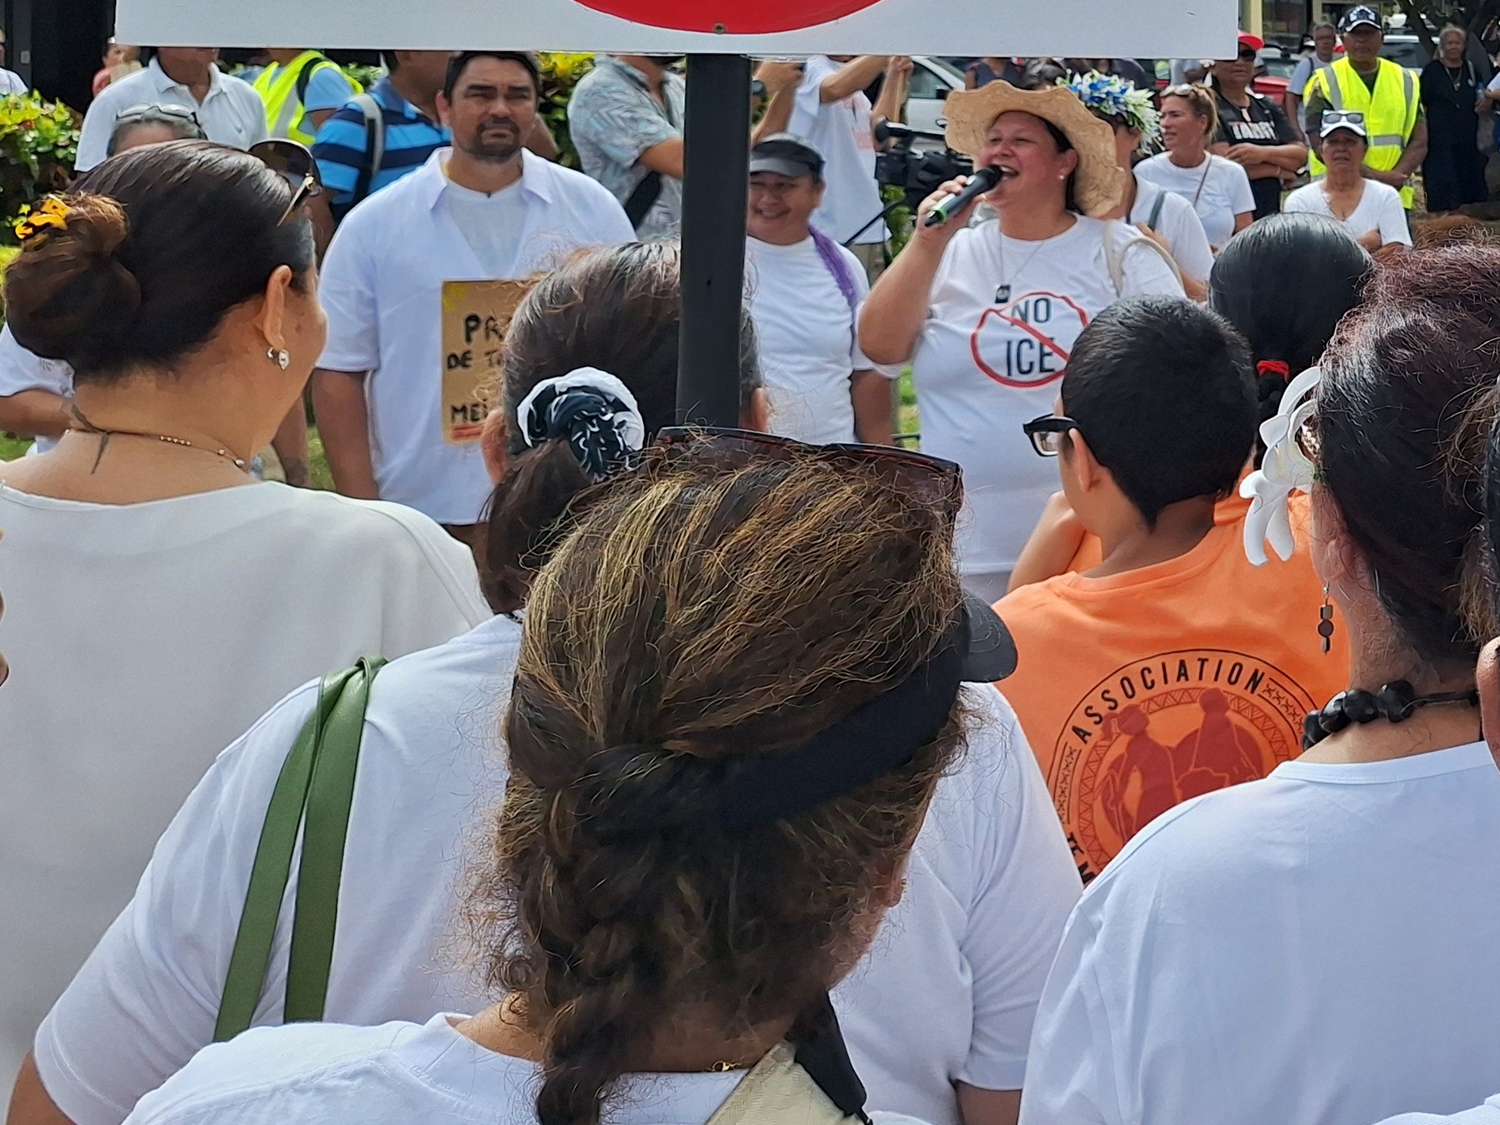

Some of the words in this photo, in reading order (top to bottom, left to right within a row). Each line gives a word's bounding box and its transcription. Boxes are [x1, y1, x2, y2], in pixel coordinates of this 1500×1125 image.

[1010, 297, 1052, 327] NO
[447, 349, 473, 370] DE
[1005, 336, 1057, 377] ICE
[1071, 657, 1266, 745] ASSOCIATION
